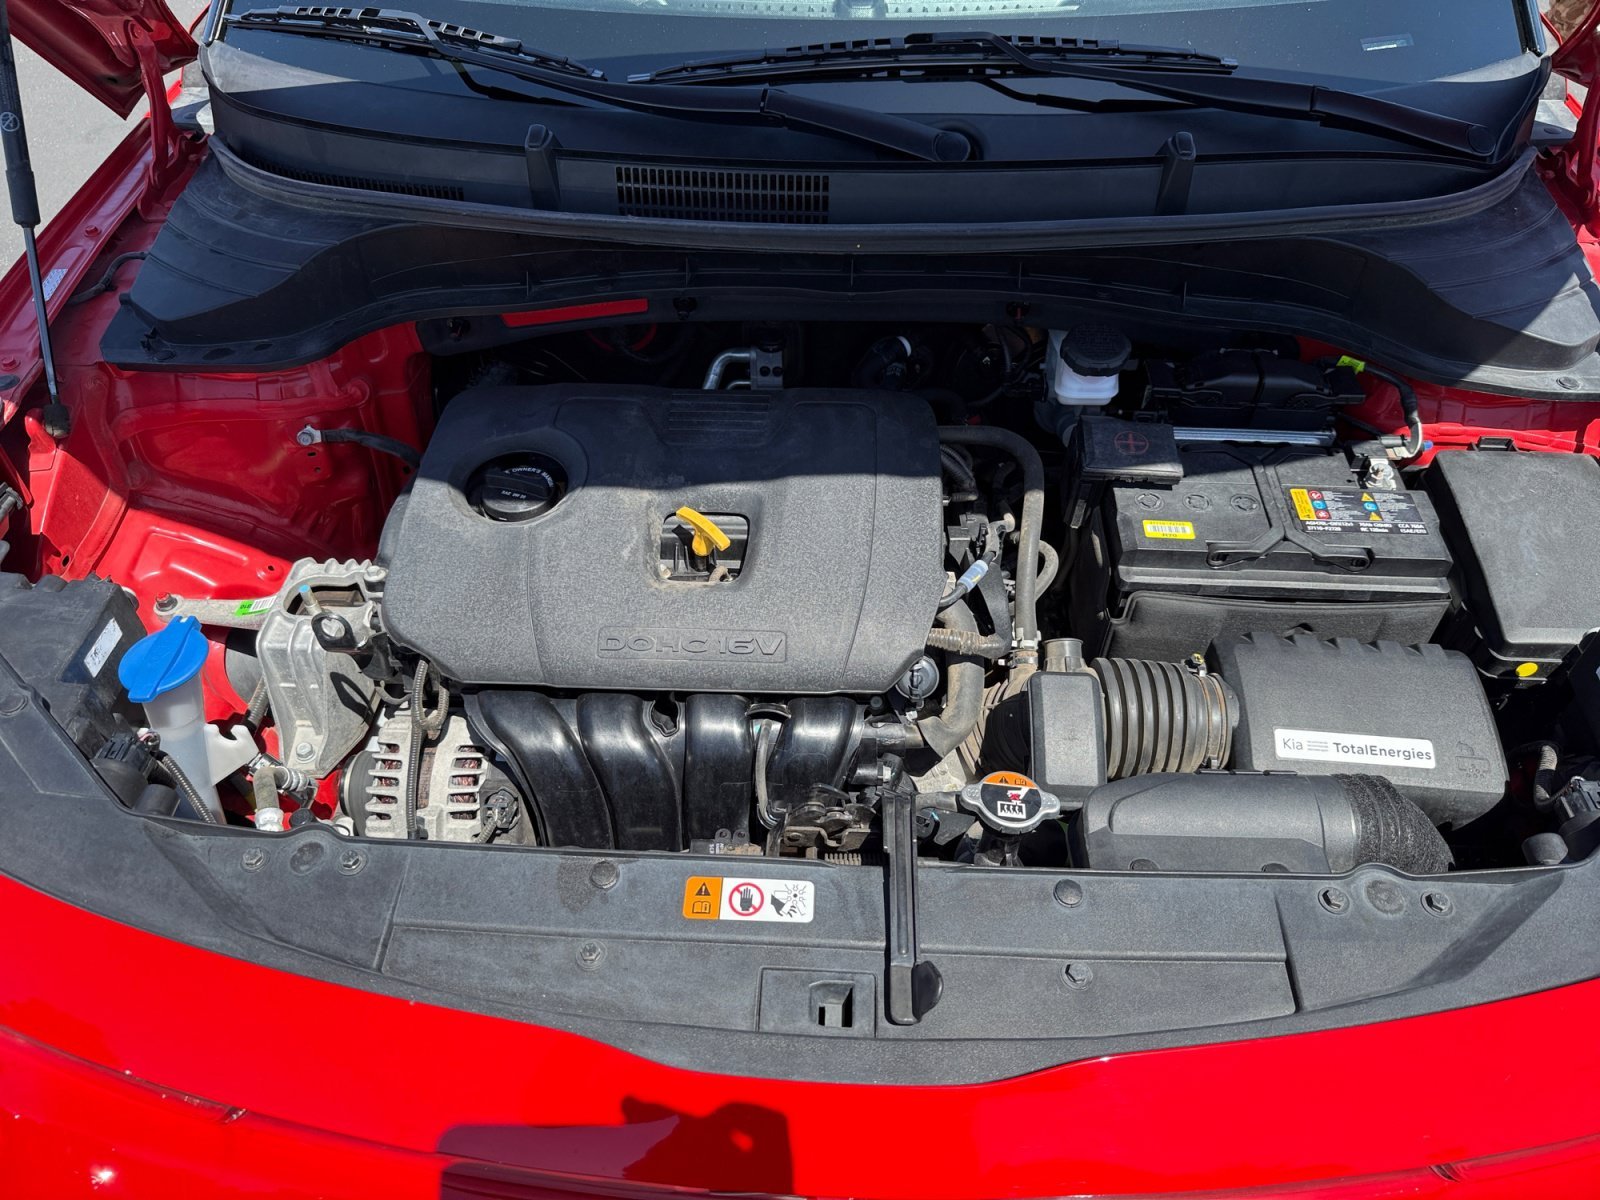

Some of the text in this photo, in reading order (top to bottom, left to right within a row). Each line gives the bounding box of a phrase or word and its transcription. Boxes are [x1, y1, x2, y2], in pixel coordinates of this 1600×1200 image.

[599, 636, 784, 656] DOHC 16V
[1282, 737, 1303, 751] Kia
[1332, 742, 1432, 761] TotalEnergies
